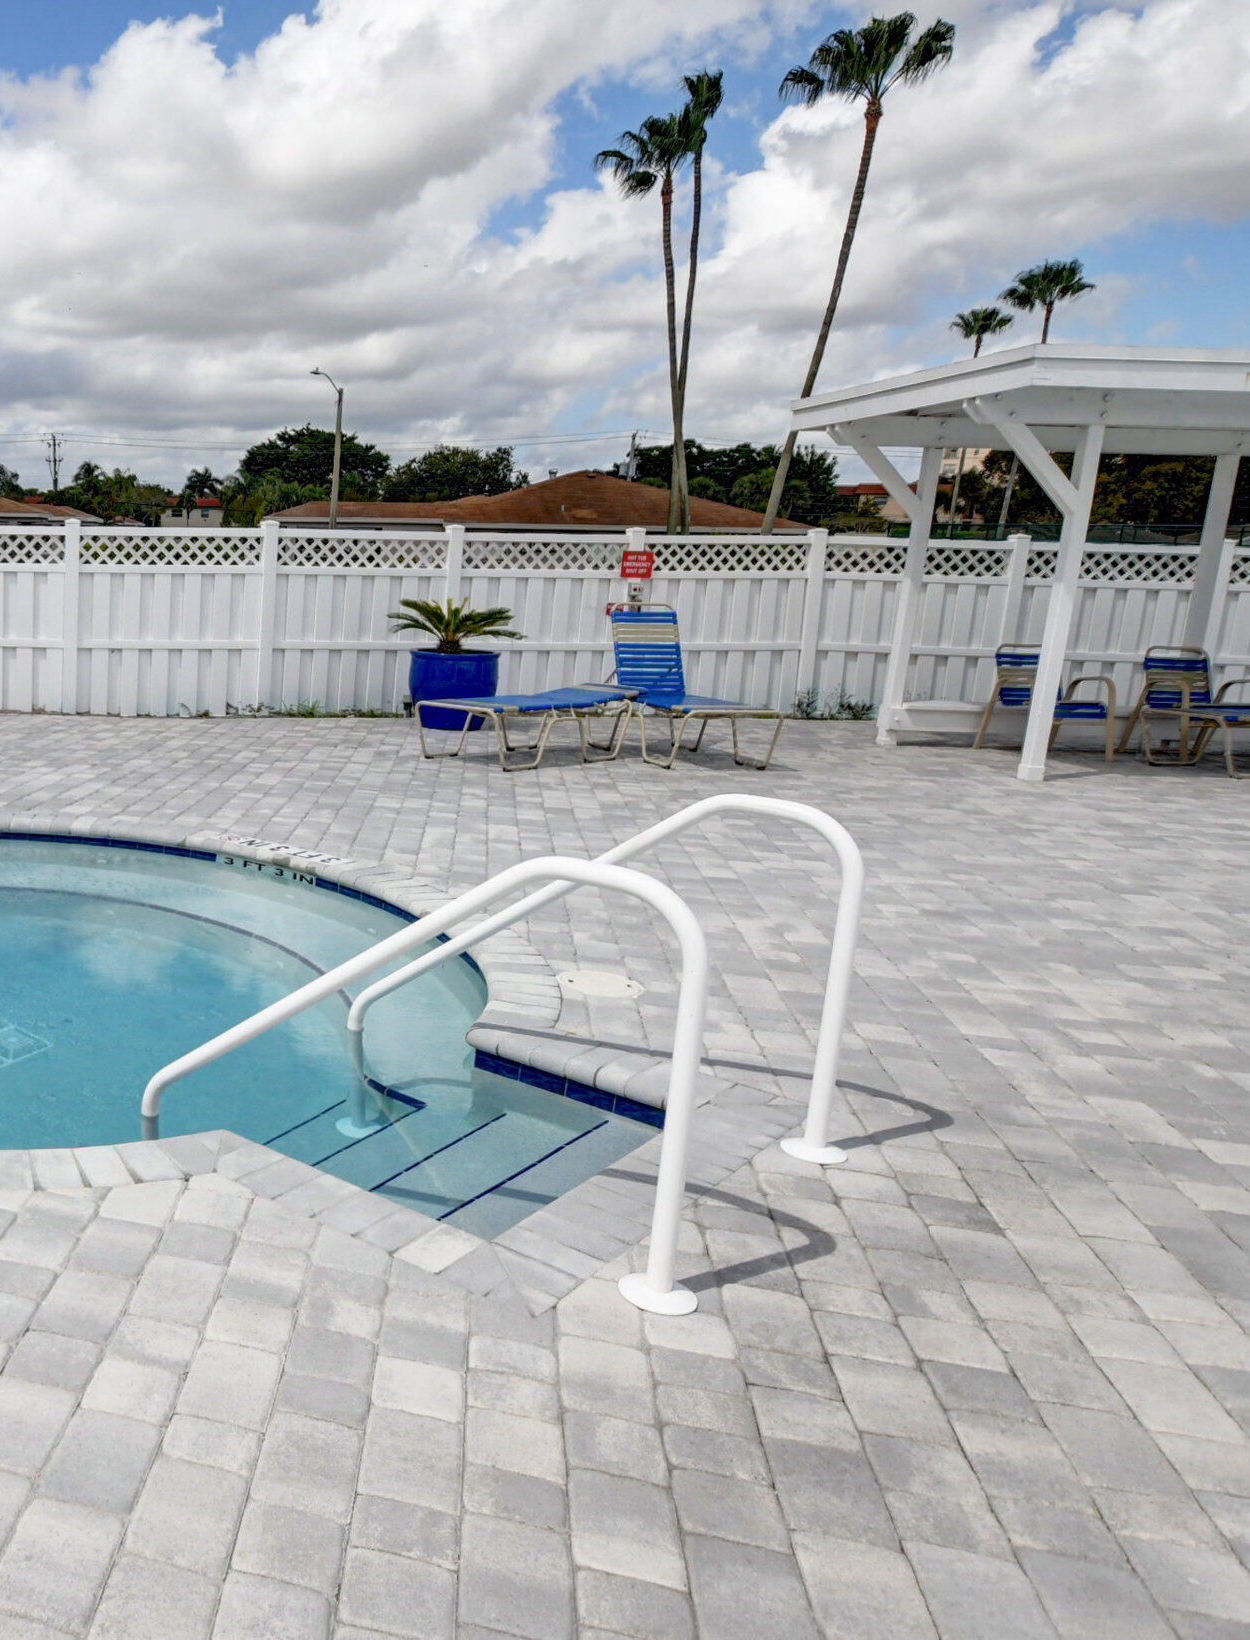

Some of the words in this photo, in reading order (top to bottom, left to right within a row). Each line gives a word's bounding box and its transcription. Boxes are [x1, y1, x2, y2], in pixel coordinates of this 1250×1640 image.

[239, 839, 270, 847] IN
[287, 850, 323, 859] FT
[224, 857, 234, 865] 3
[243, 860, 266, 871] FT
[275, 868, 284, 876] 3
[292, 873, 314, 885] IN
